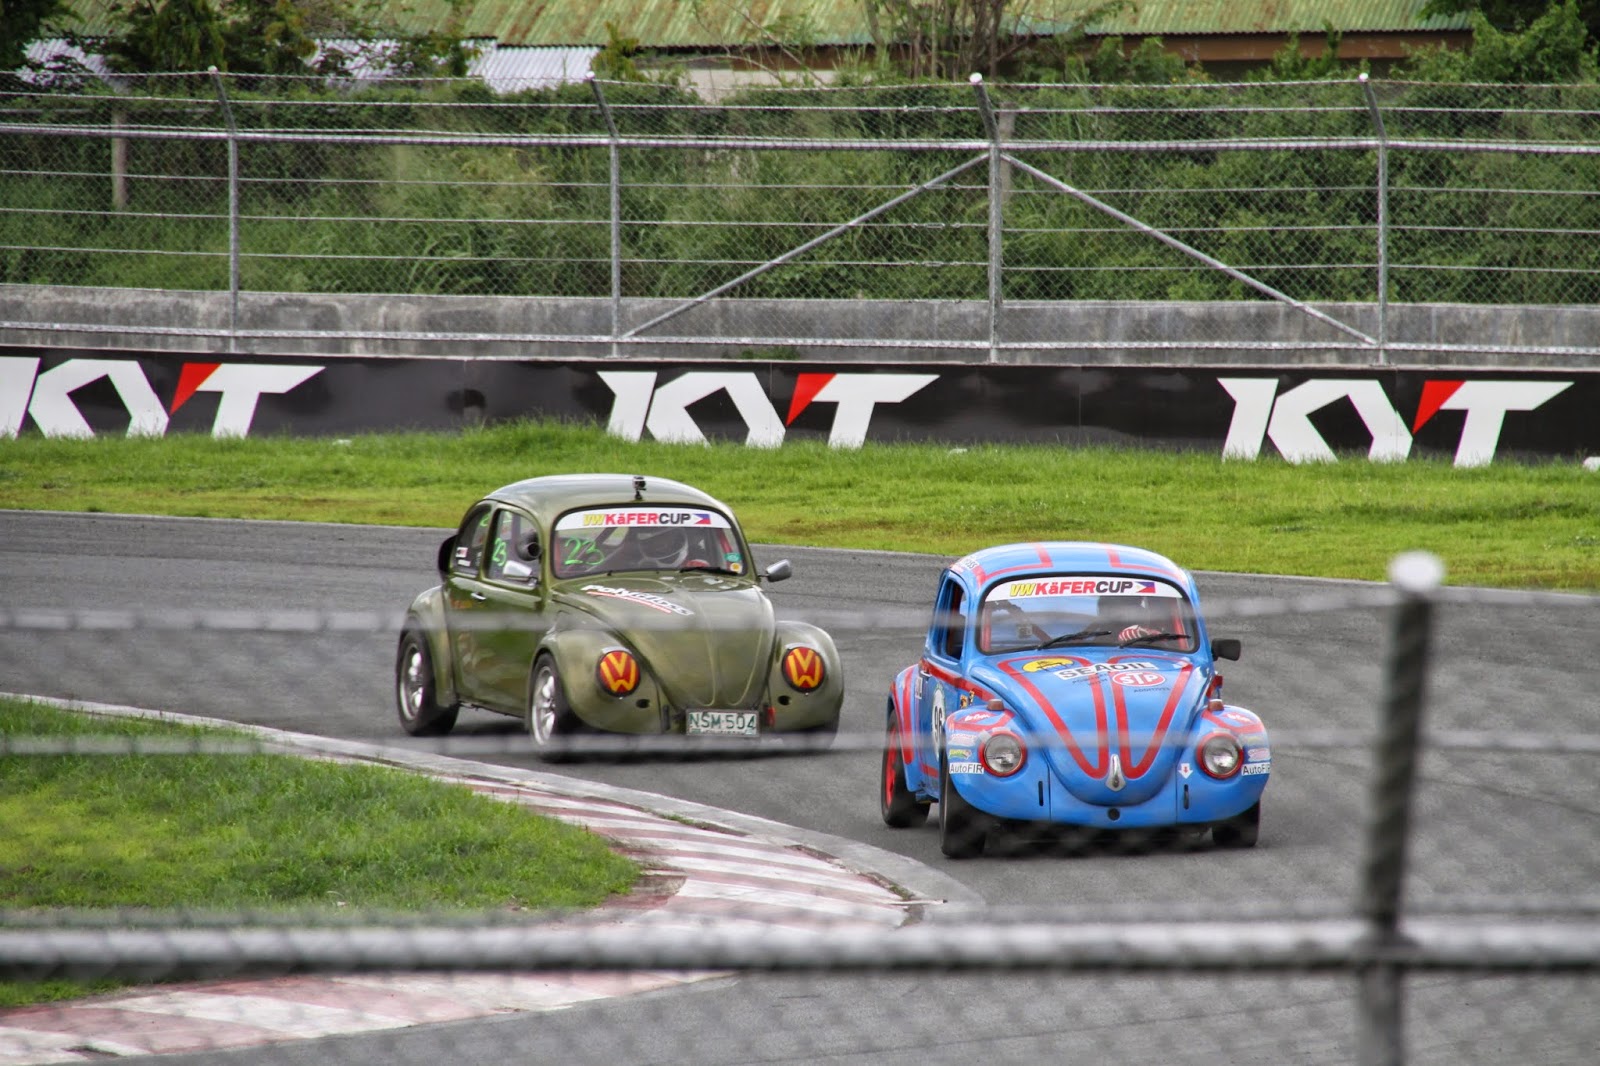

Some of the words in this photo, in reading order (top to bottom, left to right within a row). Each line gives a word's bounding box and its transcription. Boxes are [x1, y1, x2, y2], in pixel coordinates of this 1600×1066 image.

[0, 356, 326, 438] KYT
[597, 371, 941, 449] KYT
[1216, 377, 1575, 467] KYT
[565, 537, 605, 566] 23
[599, 651, 637, 693] VW
[787, 647, 821, 688] VW
[1058, 662, 1155, 679] SEAOIL
[1119, 673, 1159, 685] STP
